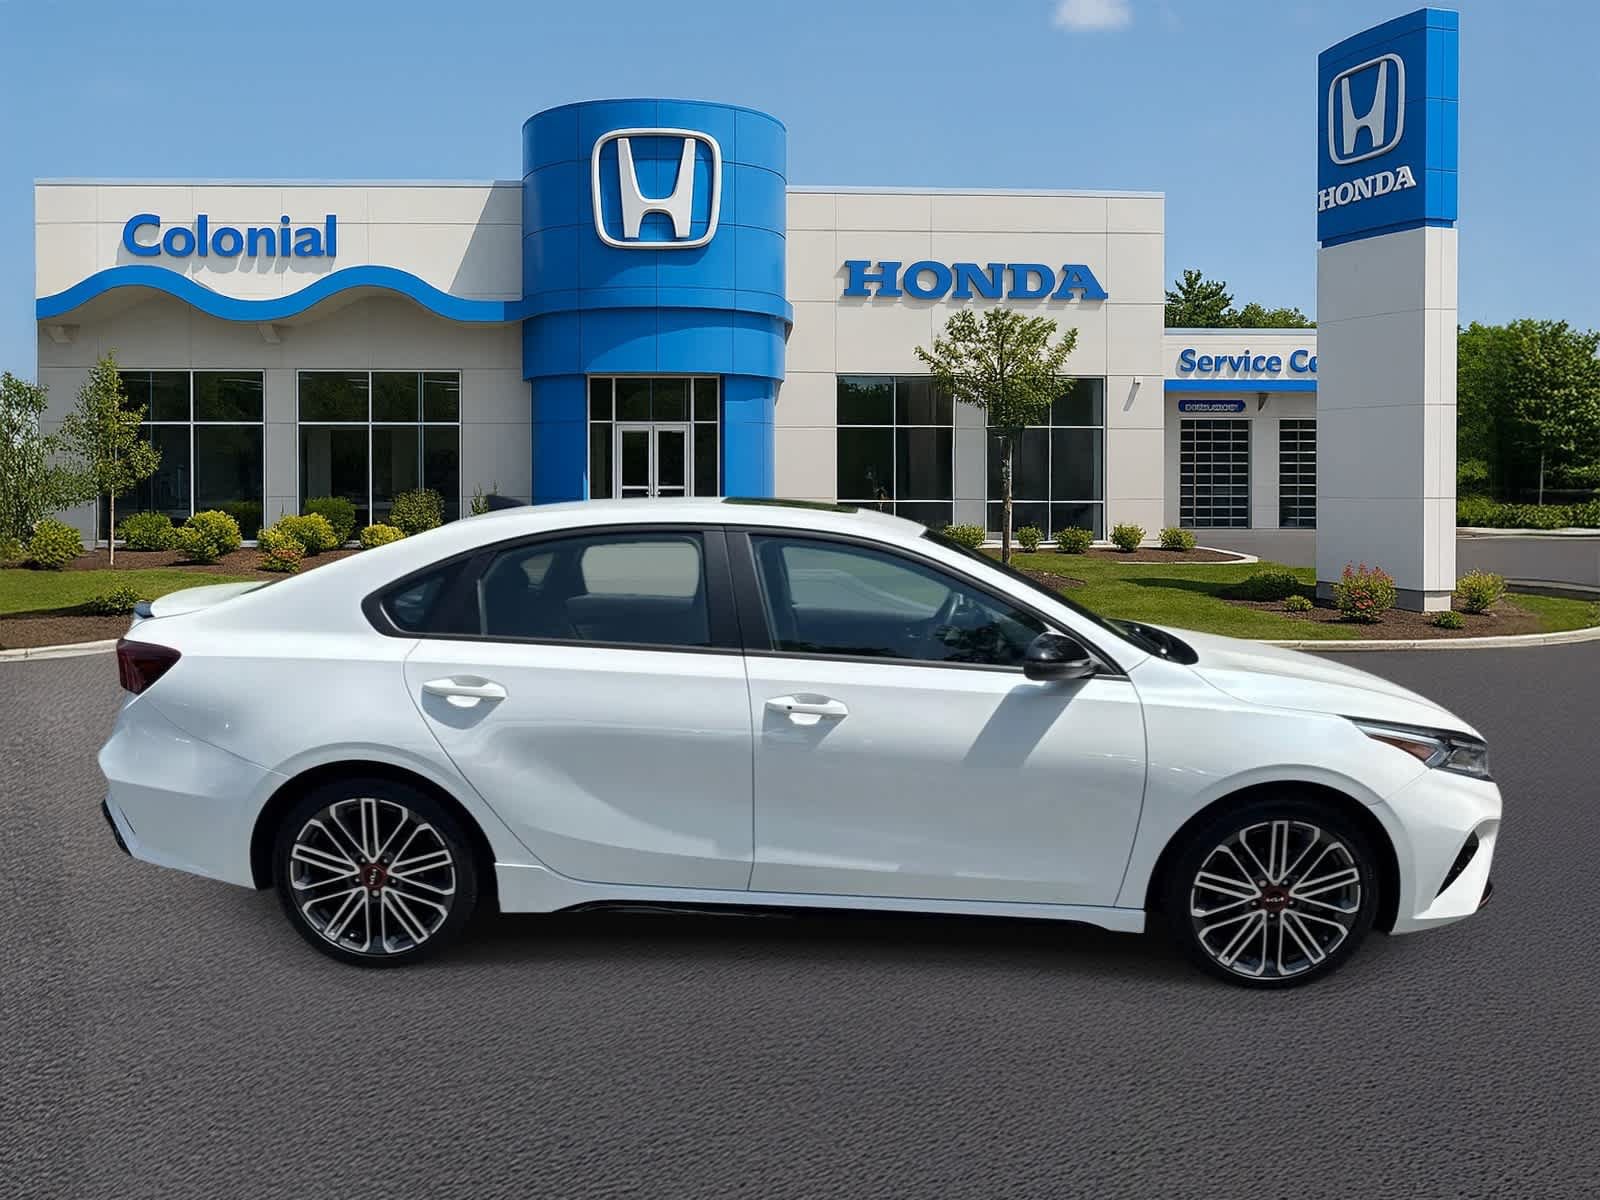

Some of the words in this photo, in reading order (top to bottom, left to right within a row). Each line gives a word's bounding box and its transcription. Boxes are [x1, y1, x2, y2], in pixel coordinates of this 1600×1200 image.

[1318, 165, 1416, 212] HONDA
[122, 213, 337, 257] Colonial
[843, 260, 1109, 300] HONDA
[1180, 348, 1282, 372] Service
